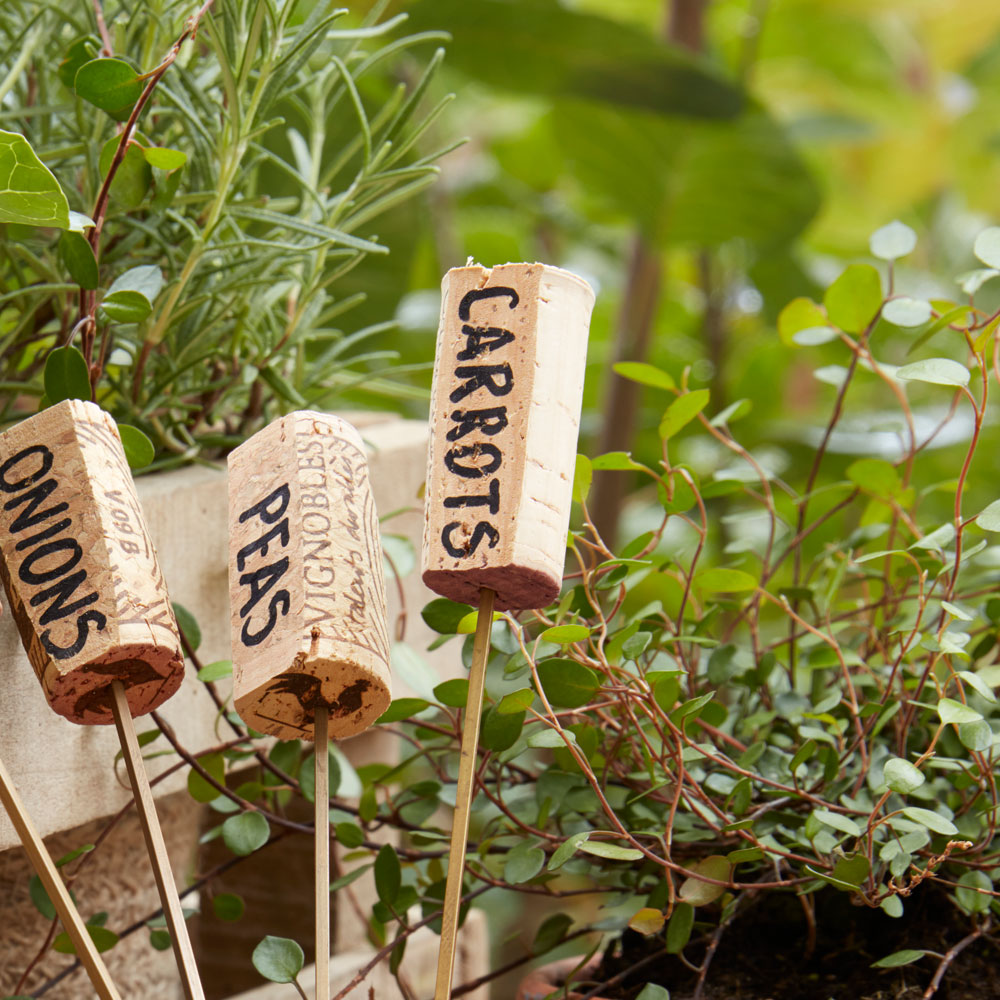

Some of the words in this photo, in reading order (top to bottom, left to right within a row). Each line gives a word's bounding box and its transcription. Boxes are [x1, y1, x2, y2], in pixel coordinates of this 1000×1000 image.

[441, 286, 519, 558] CARROTS
[237, 482, 291, 647] PEAS
[298, 440, 336, 628] VIGNOBLES
